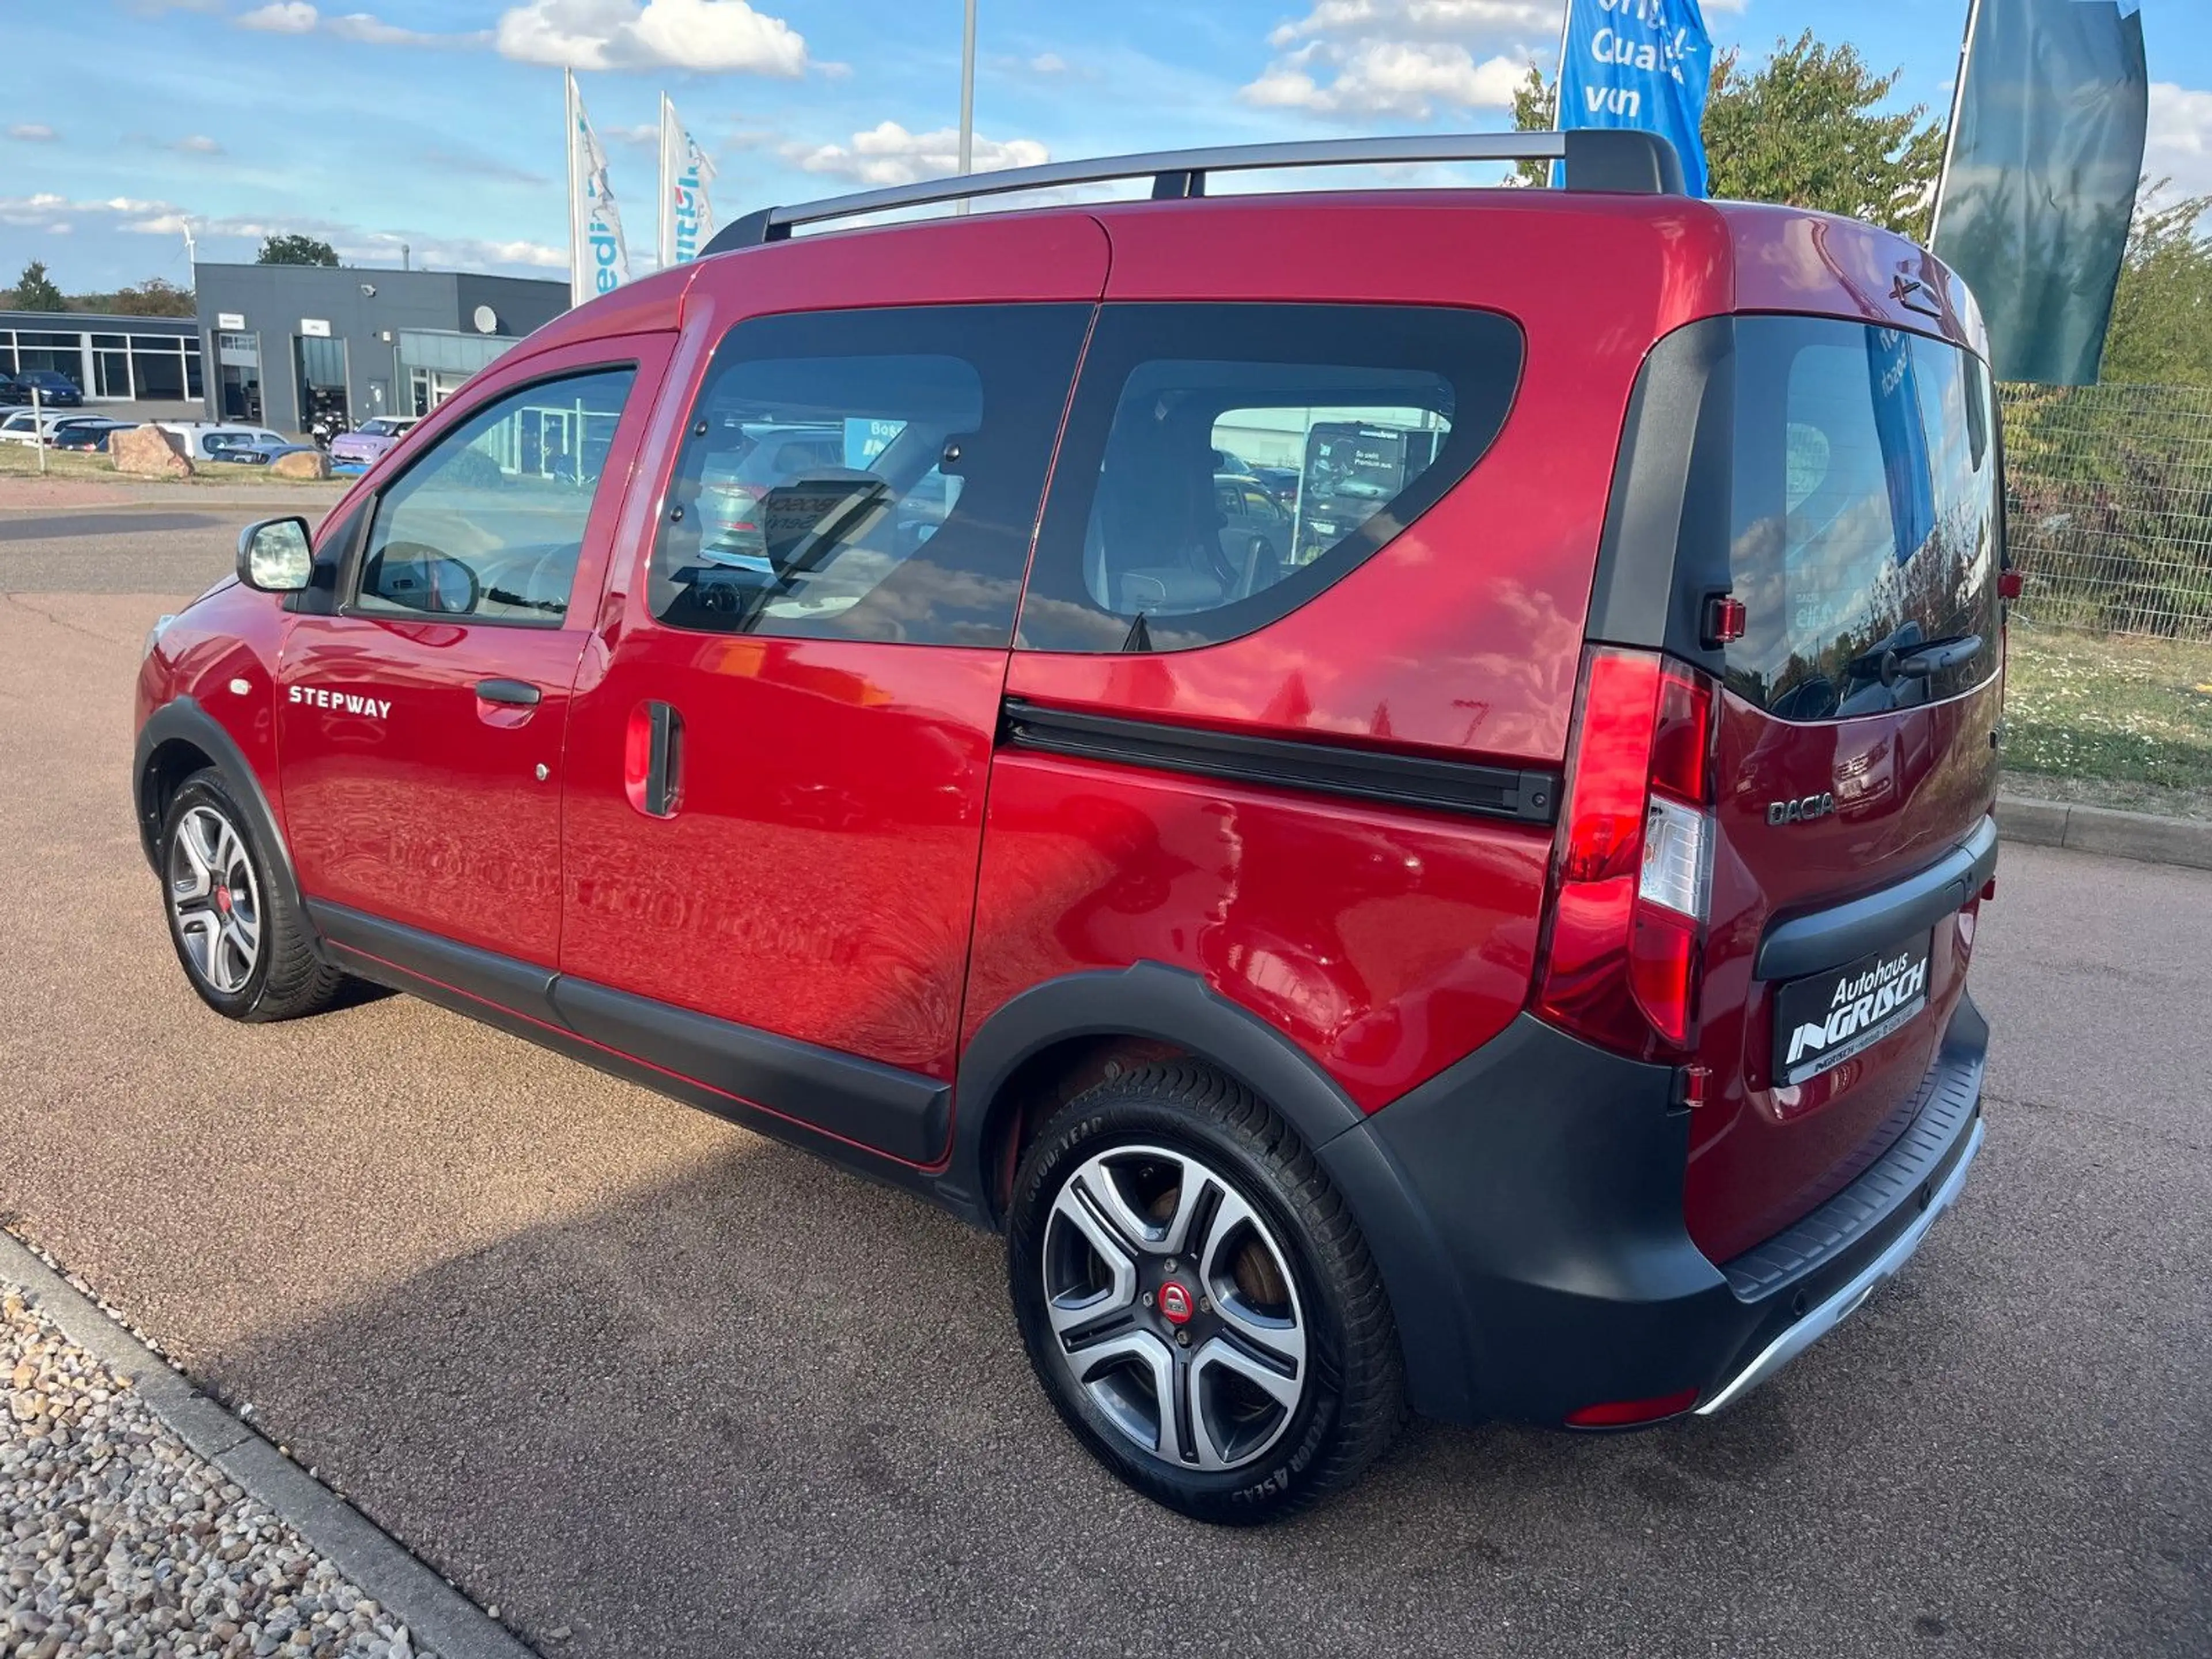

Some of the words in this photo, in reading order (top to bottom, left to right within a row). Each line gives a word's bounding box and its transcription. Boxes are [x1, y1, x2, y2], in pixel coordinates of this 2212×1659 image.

[289, 685, 392, 719] STEPWAY
[1768, 792, 1834, 825] DACIA
[1831, 952, 1908, 1009] Autohaus
[1785, 957, 1925, 1065] INGRISCH
